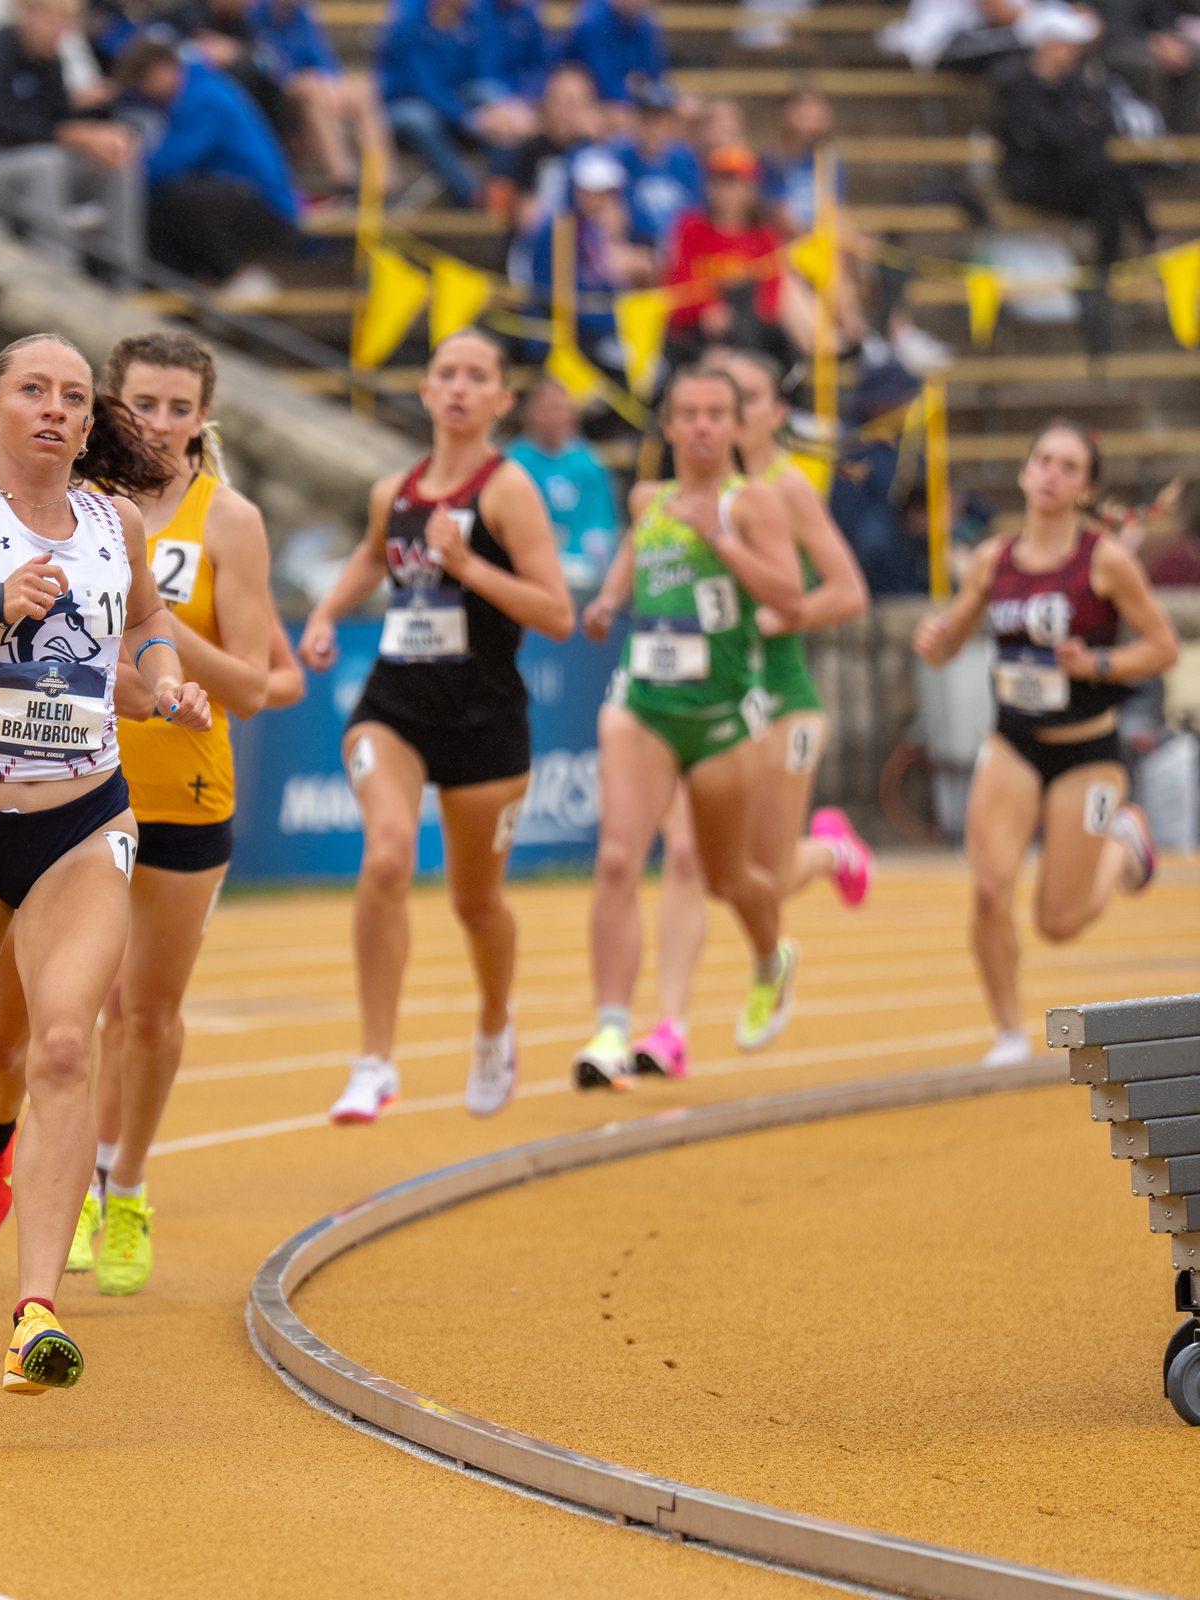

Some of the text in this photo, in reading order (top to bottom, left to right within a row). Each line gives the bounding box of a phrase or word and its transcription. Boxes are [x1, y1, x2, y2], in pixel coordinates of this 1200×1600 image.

[158, 547, 186, 597] 2
[98, 591, 123, 636] 11
[26, 700, 73, 721] HELEN
[1, 719, 89, 744] BRAYBROOK
